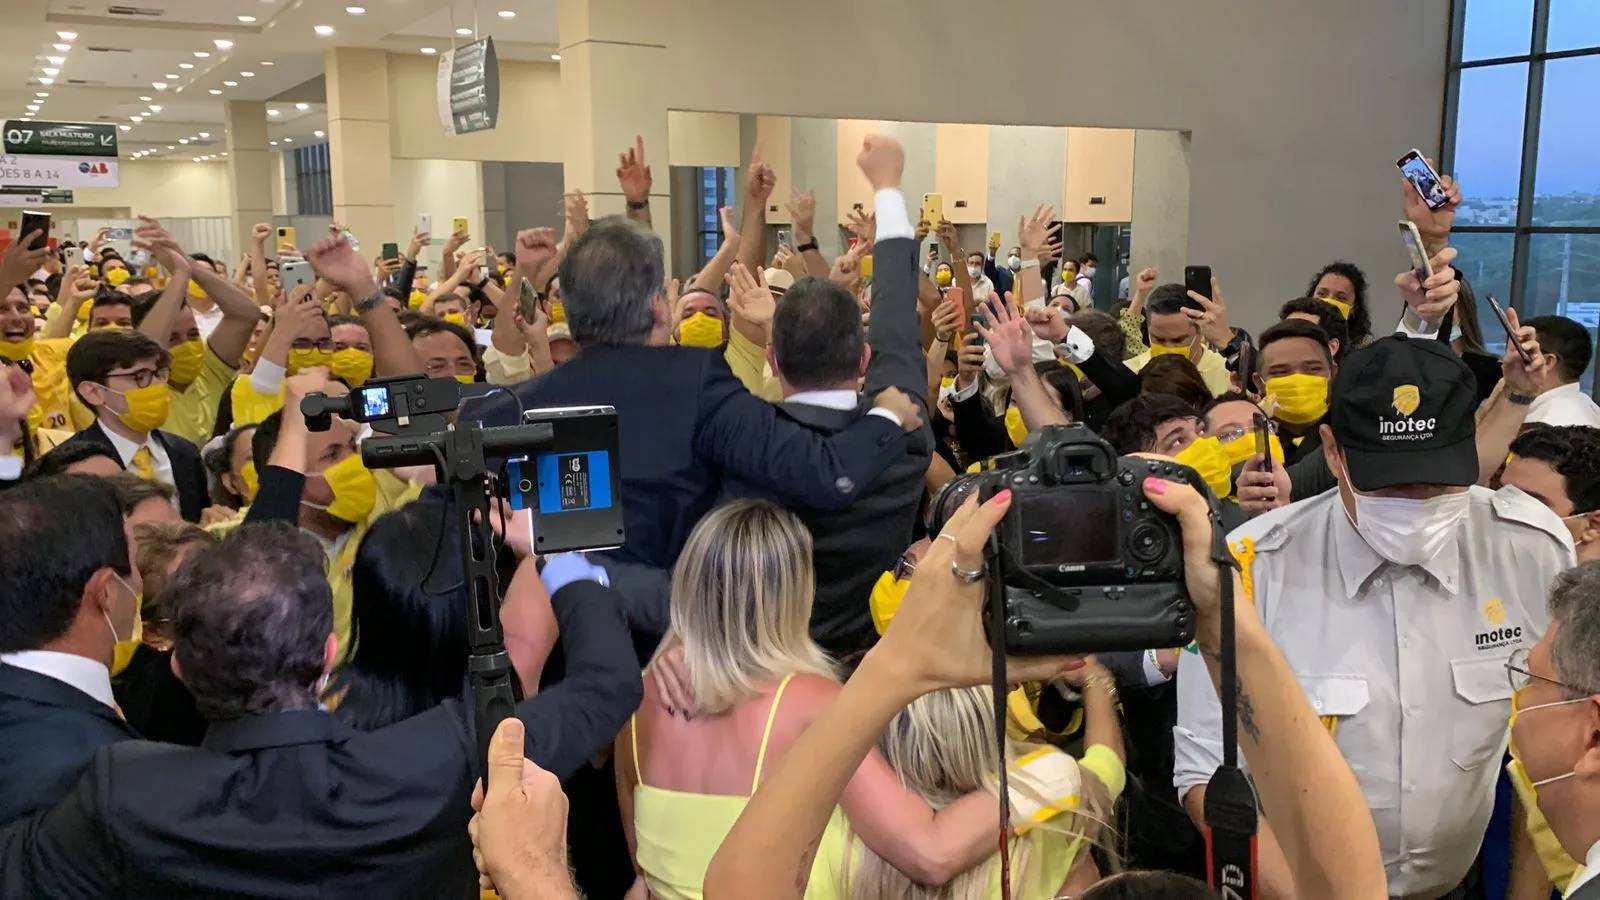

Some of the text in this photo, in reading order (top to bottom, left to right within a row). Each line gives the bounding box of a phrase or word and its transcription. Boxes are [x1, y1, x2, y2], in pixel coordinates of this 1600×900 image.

[8, 129, 34, 144] 07
[10, 155, 17, 165] 2
[23, 169, 31, 179] 8
[35, 170, 42, 178] A
[46, 170, 60, 179] 14
[48, 414, 66, 427] 20
[1379, 416, 1436, 434] inotec
[1058, 564, 1086, 573] Canon
[1475, 626, 1522, 645] inotec
